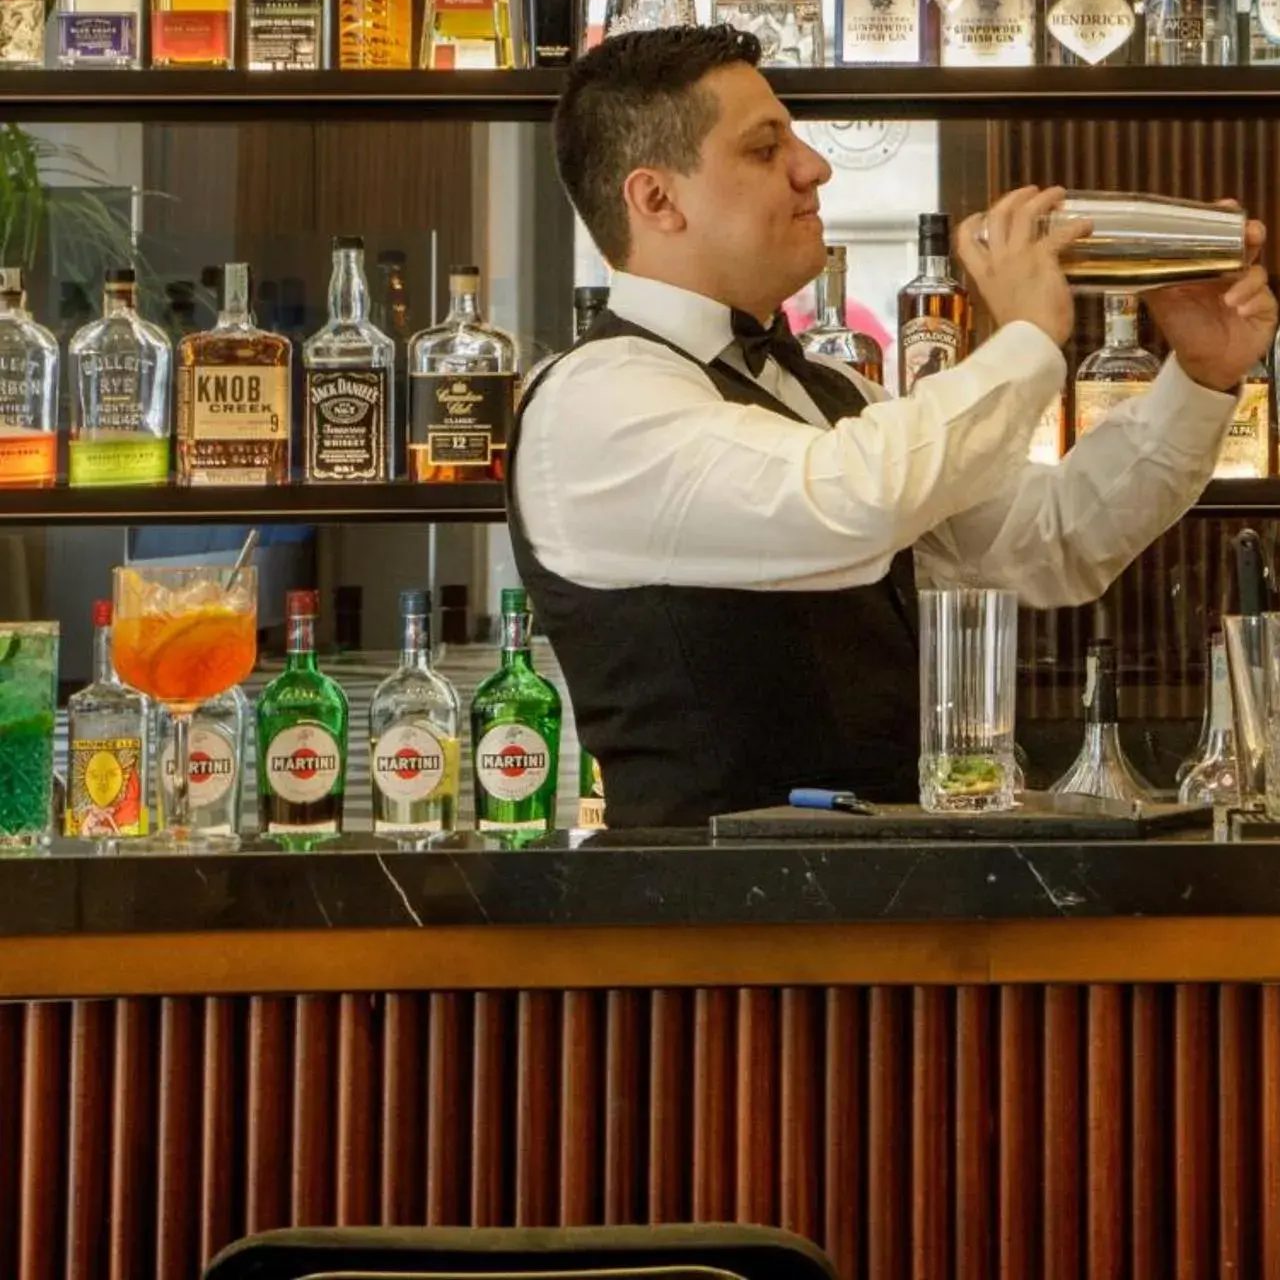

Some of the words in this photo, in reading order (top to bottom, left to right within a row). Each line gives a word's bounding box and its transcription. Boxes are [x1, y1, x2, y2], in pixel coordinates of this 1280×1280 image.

[954, 24, 1023, 34] GUNPOWDER
[962, 34, 992, 43] IRISH
[996, 34, 1015, 43] GIN
[198, 375, 261, 403] KNOB
[312, 384, 337, 404] JACK
[337, 377, 380, 404] DANIEL'S
[209, 404, 273, 413] CREEK
[270, 414, 279, 433] 9
[452, 436, 466, 449] 12
[168, 760, 231, 775] MRTINI
[272, 757, 336, 771] MARTINI
[378, 757, 440, 771] MARTINI
[482, 755, 545, 768] MARTINI
